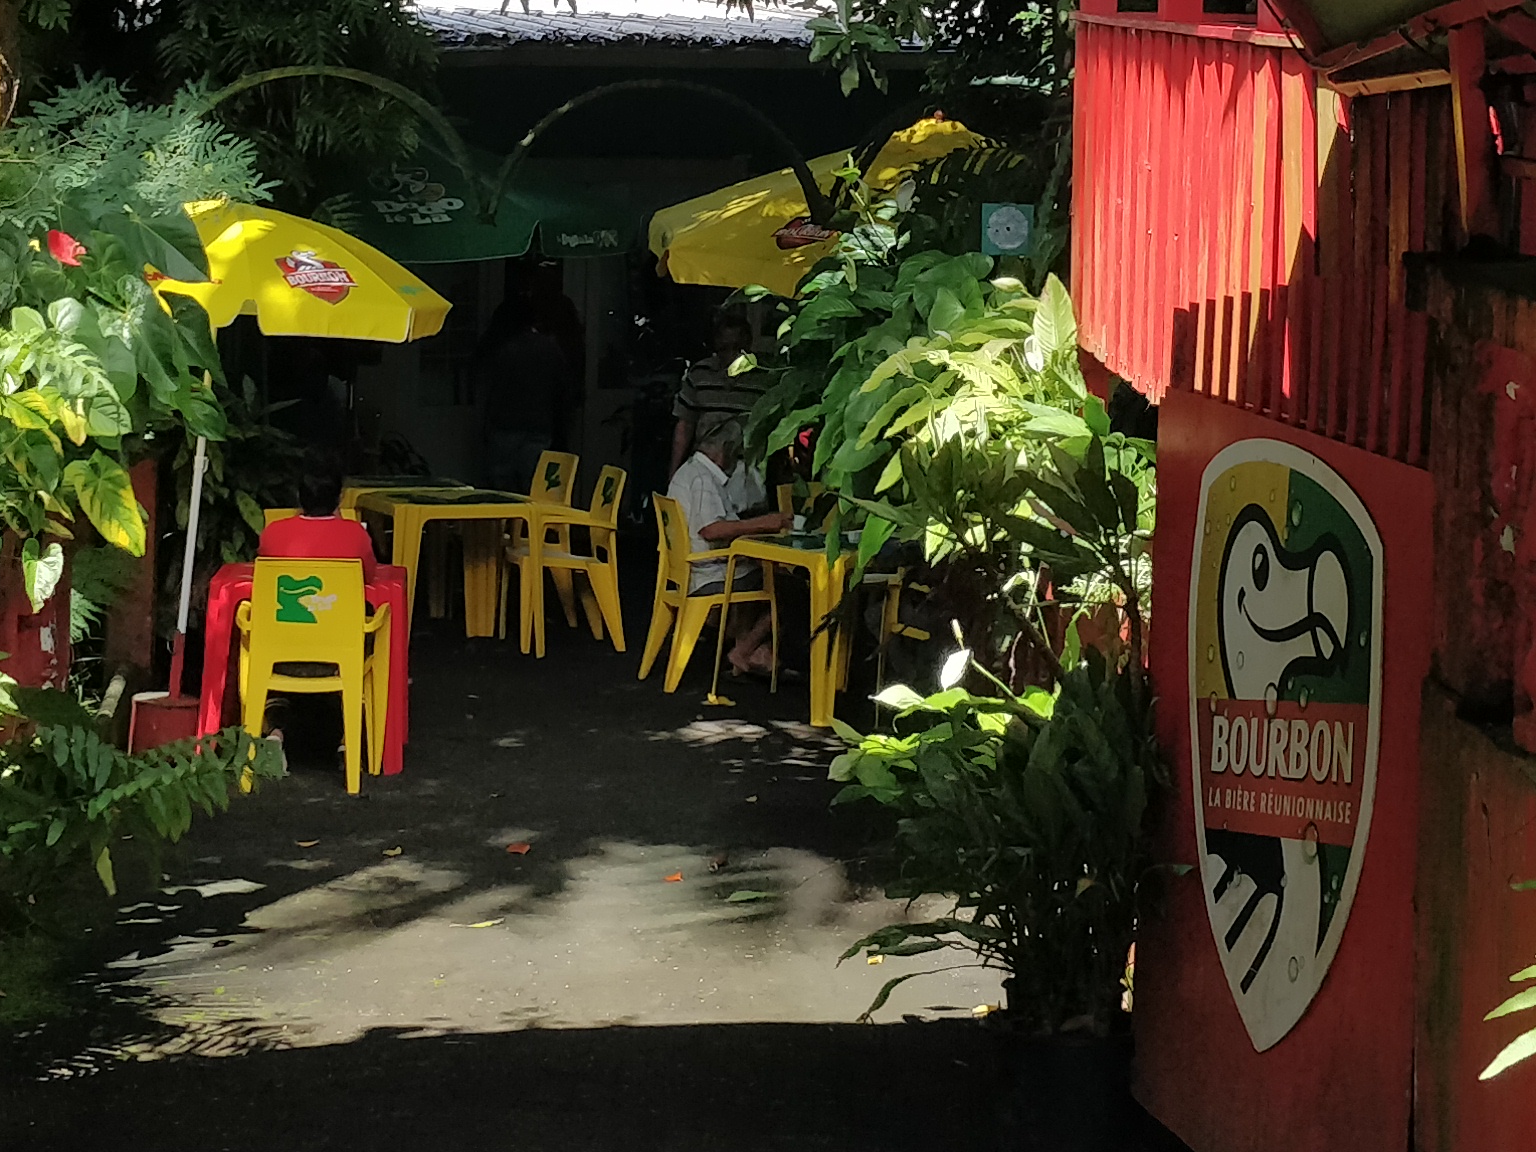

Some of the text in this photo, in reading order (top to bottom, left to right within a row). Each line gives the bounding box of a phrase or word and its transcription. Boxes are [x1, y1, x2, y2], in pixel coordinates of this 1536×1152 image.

[286, 270, 350, 285] BOURBON
[1211, 715, 1354, 783] BOURBON
[1208, 784, 1352, 824] LA BIÈRE RÉUNIONNAISE
